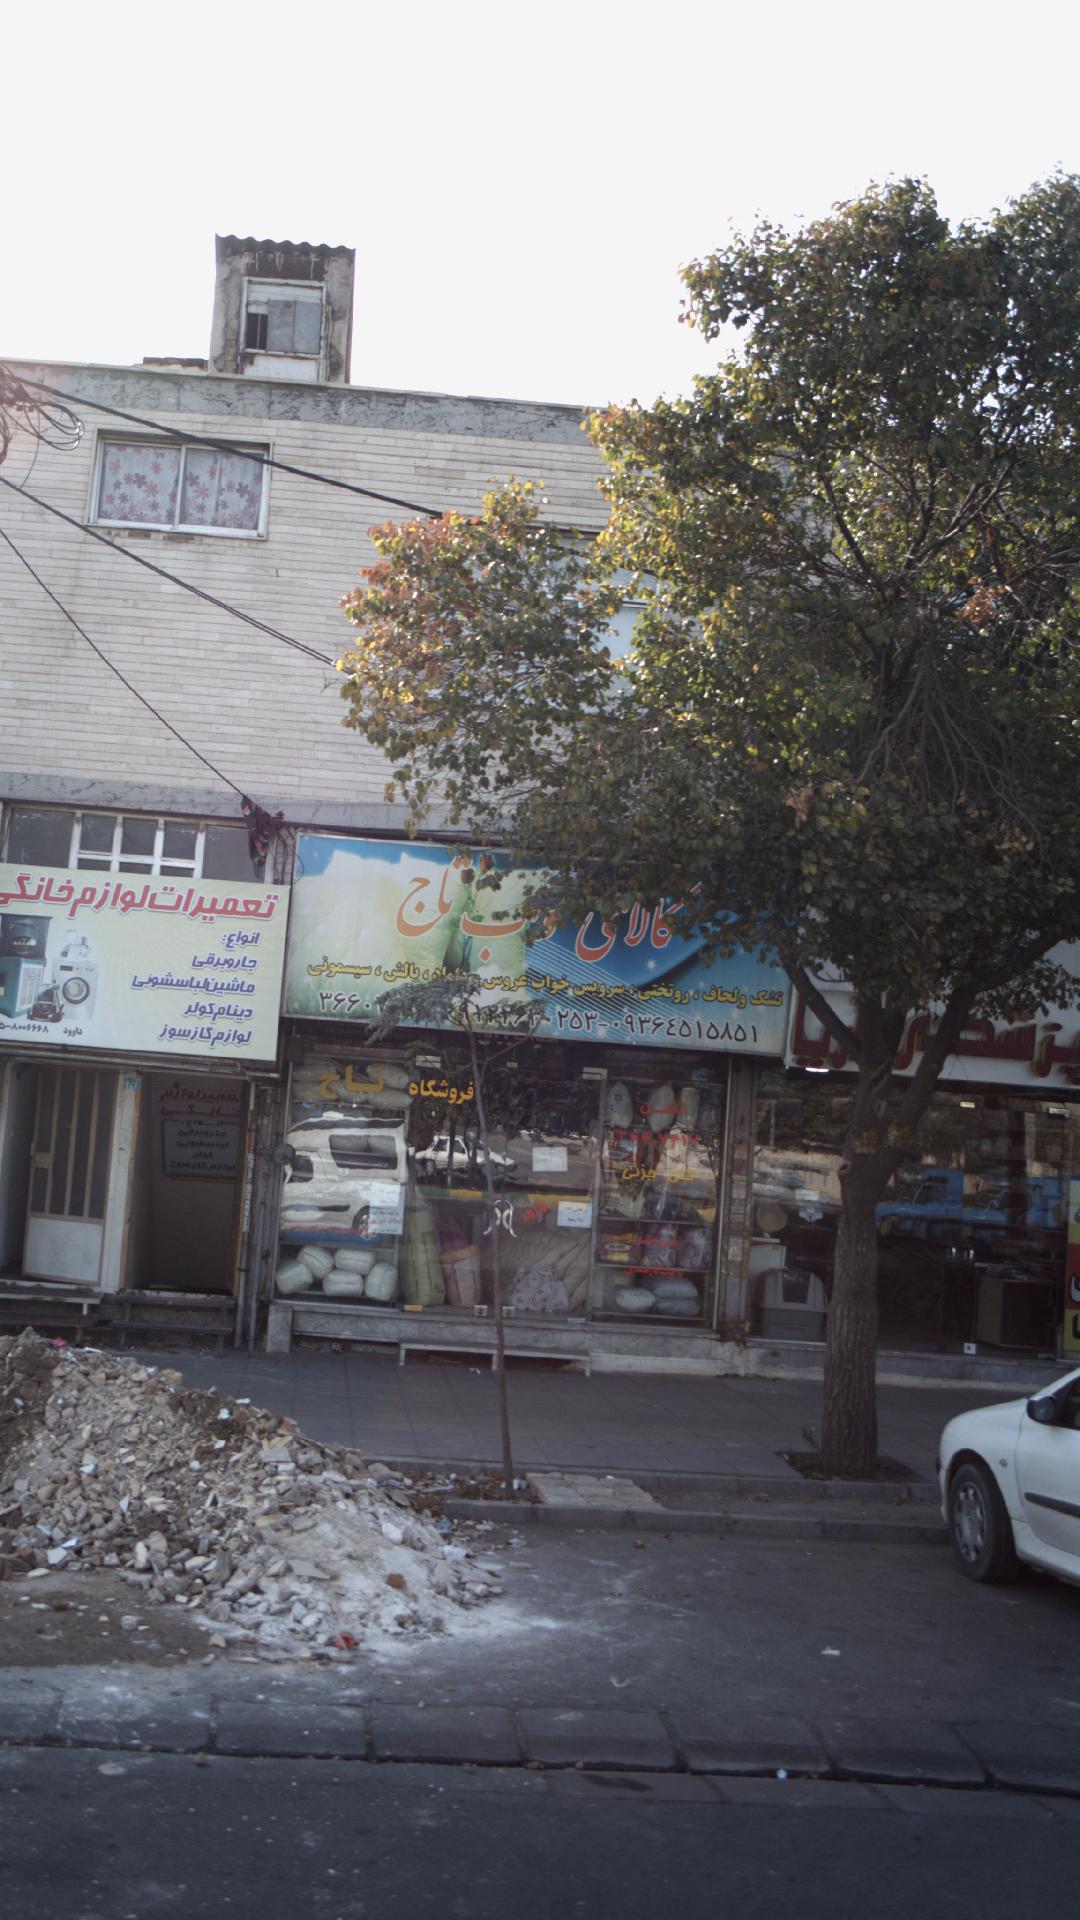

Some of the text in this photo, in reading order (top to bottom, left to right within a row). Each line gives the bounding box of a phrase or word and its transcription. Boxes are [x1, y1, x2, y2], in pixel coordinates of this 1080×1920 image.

[69, 882, 150, 917] لوازم
[149, 886, 280, 921] تعمیرات
[482, 973, 528, 992] عروس
[750, 989, 784, 1007] تشک
[408, 1078, 475, 1104] فروشگاه
